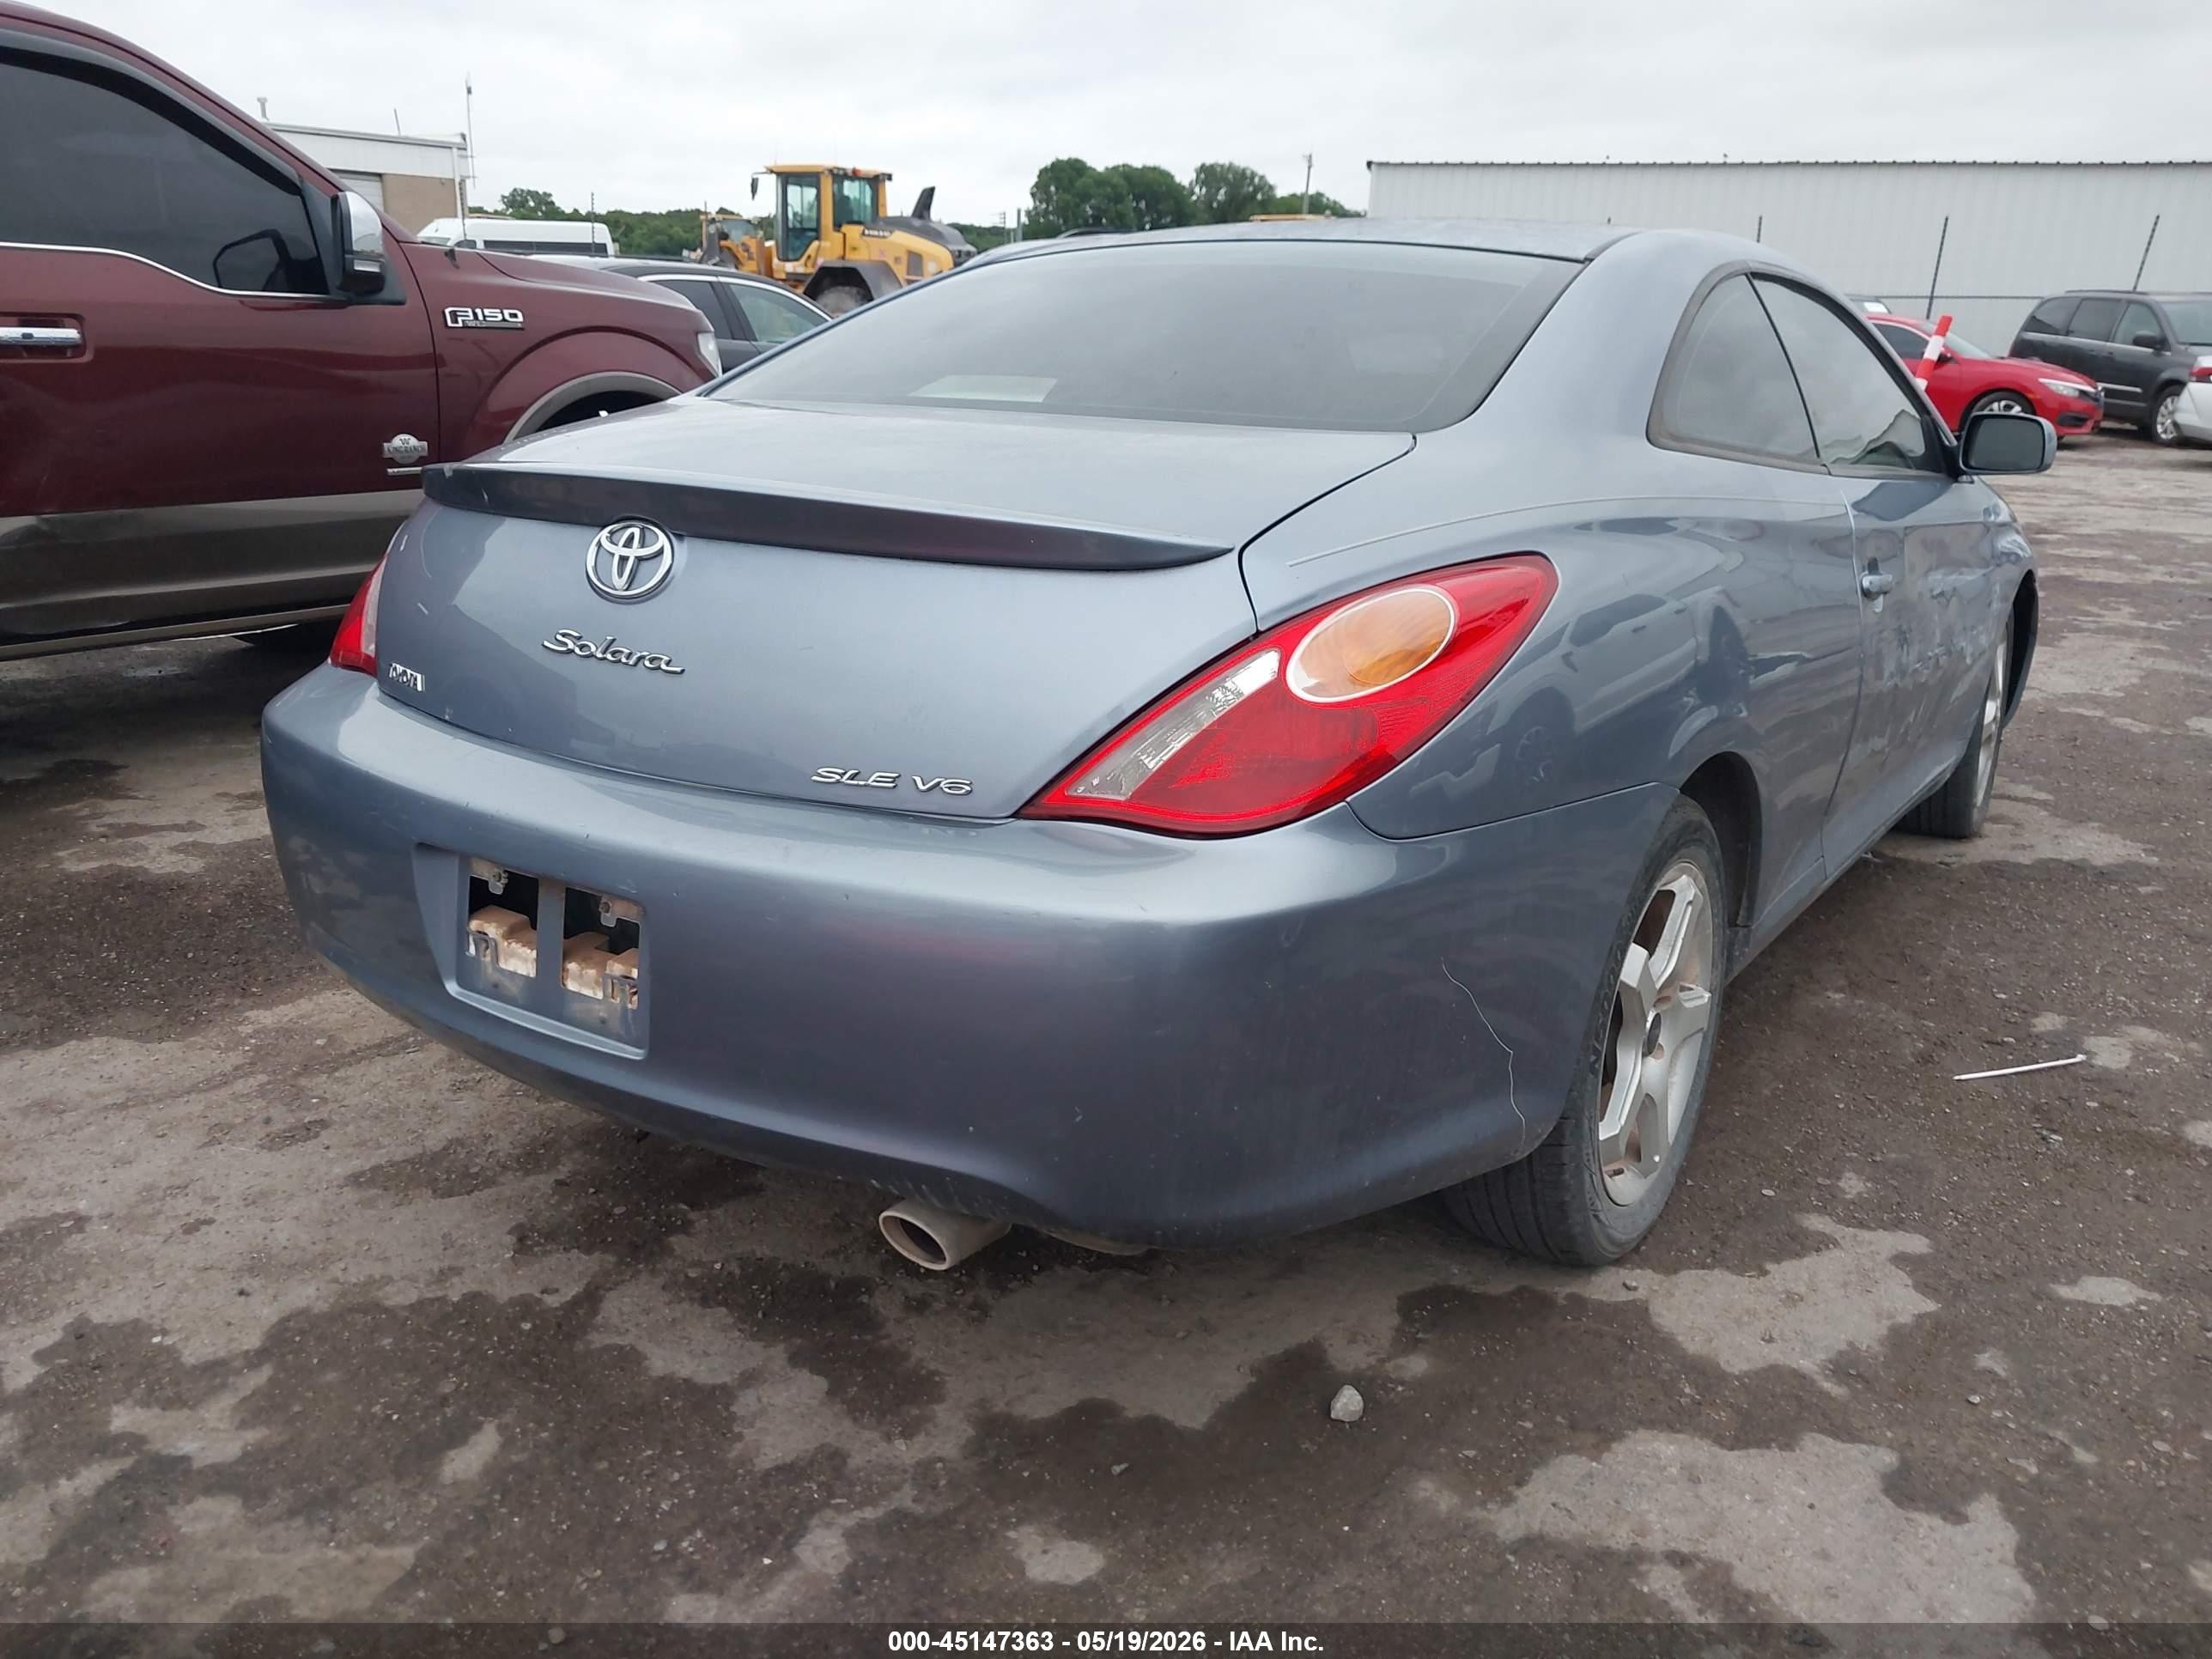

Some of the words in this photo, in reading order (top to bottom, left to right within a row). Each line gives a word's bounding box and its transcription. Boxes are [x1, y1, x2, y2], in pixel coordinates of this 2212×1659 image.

[541, 629, 685, 674] Solara
[811, 767, 901, 788] SLE
[911, 775, 972, 795] V6
